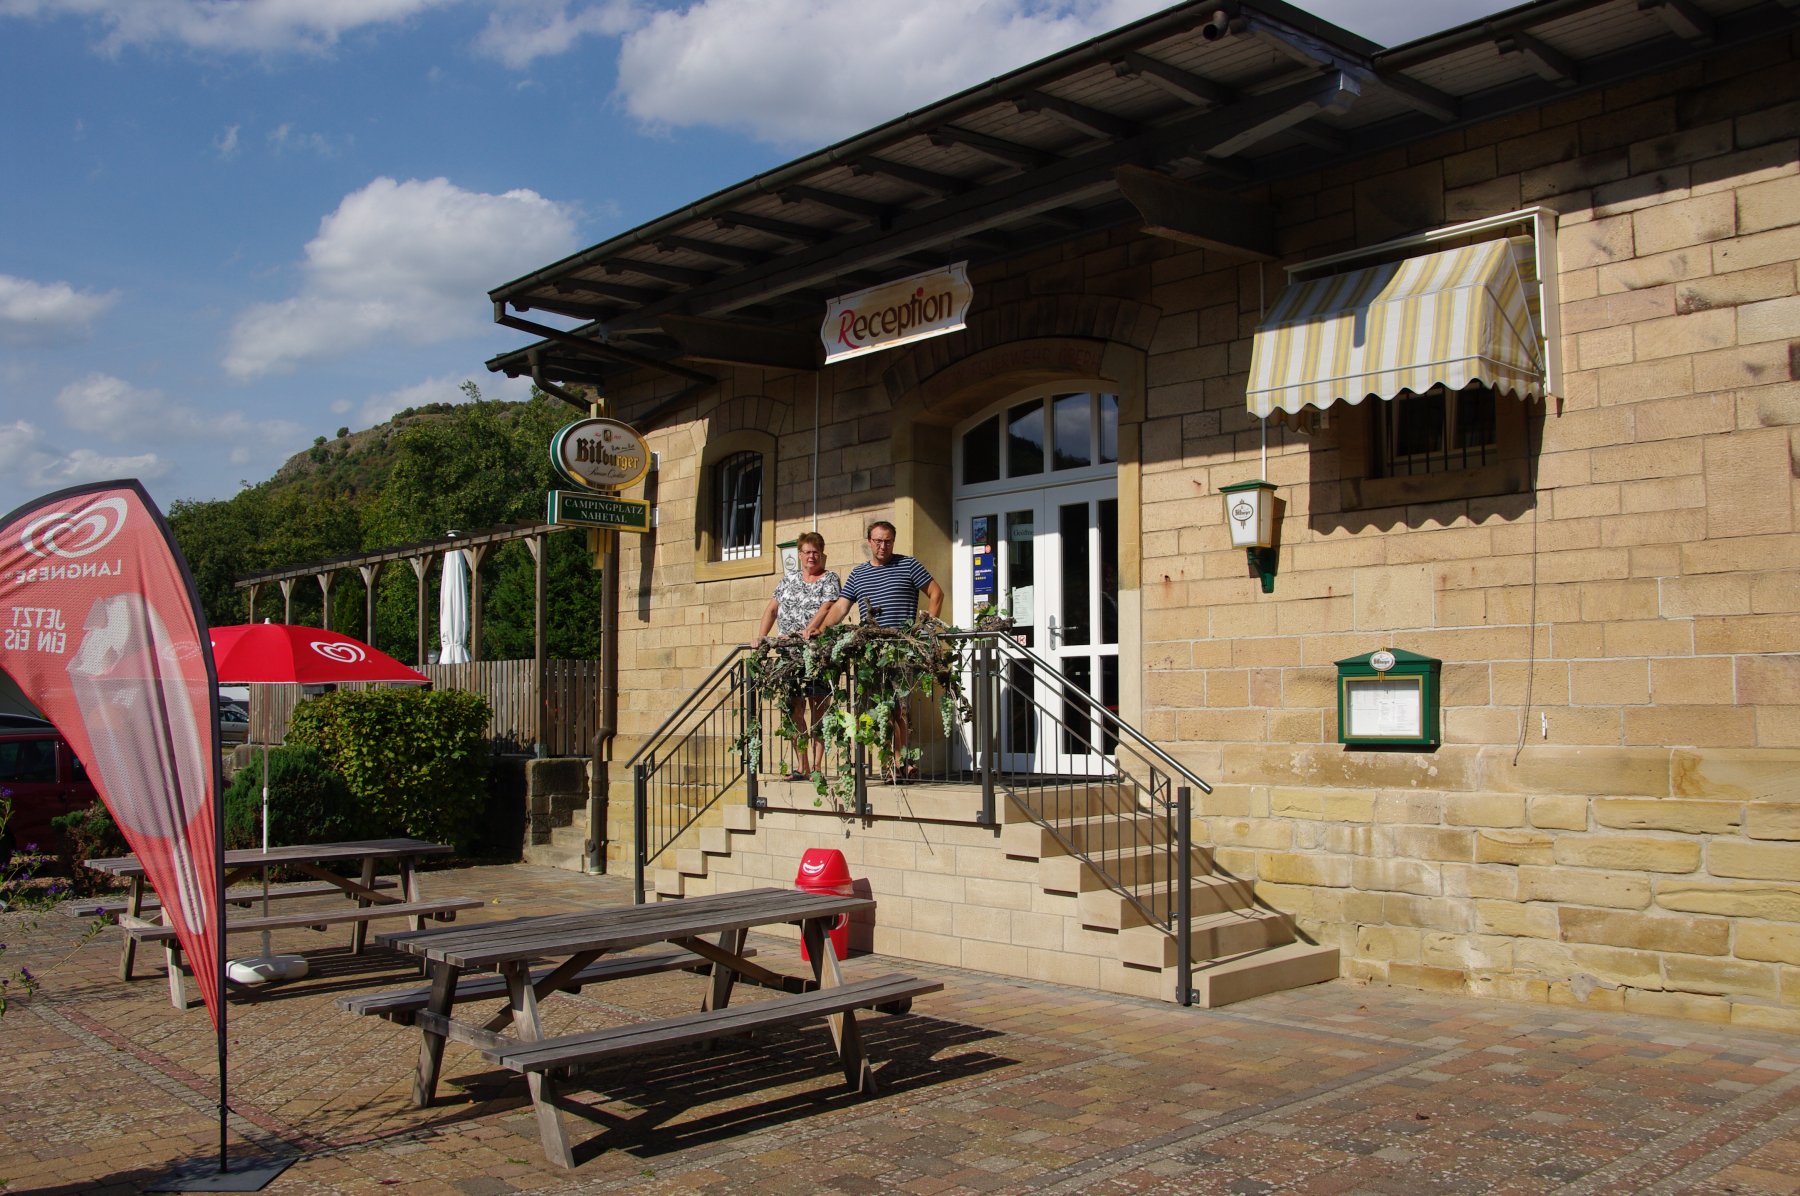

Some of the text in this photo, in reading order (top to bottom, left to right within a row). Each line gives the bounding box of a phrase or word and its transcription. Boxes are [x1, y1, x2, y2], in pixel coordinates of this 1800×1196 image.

[838, 287, 953, 349] Reception
[575, 437, 639, 471] Bitburger
[564, 498, 644, 515] CAMPINGPLATZ
[581, 510, 628, 524] NAHETAL
